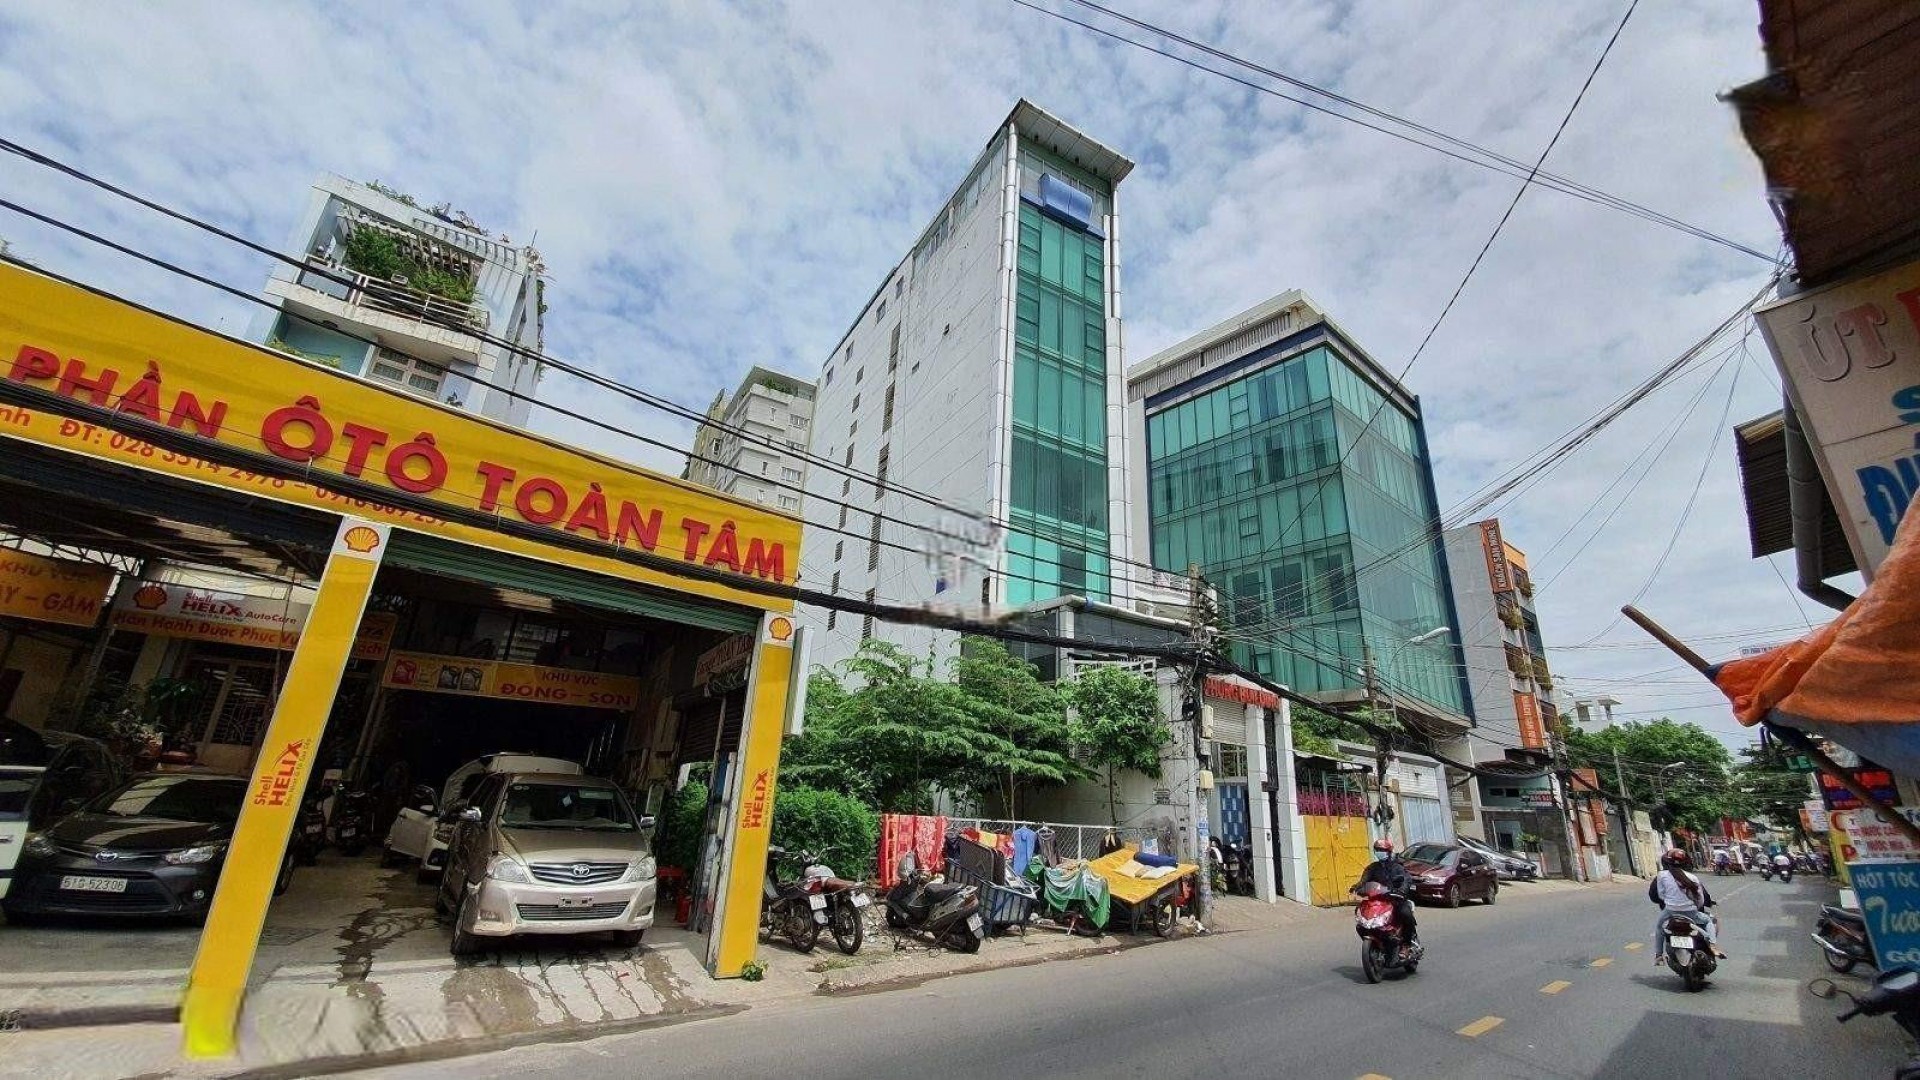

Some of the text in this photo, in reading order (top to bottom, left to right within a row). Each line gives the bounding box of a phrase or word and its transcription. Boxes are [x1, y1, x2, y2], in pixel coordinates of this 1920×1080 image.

[59, 419, 102, 444] ĐT:
[8, 344, 228, 439] PHẦN
[262, 395, 448, 493] ÔTÔ
[477, 460, 663, 551] TOÀN
[683, 518, 784, 582] TÂM
[181, 600, 242, 618] HELIX
[541, 671, 570, 684] KHU
[268, 742, 303, 805] HELIX
[254, 775, 273, 805] Shell
[750, 771, 768, 827] HELIX
[742, 802, 753, 828] Shell
